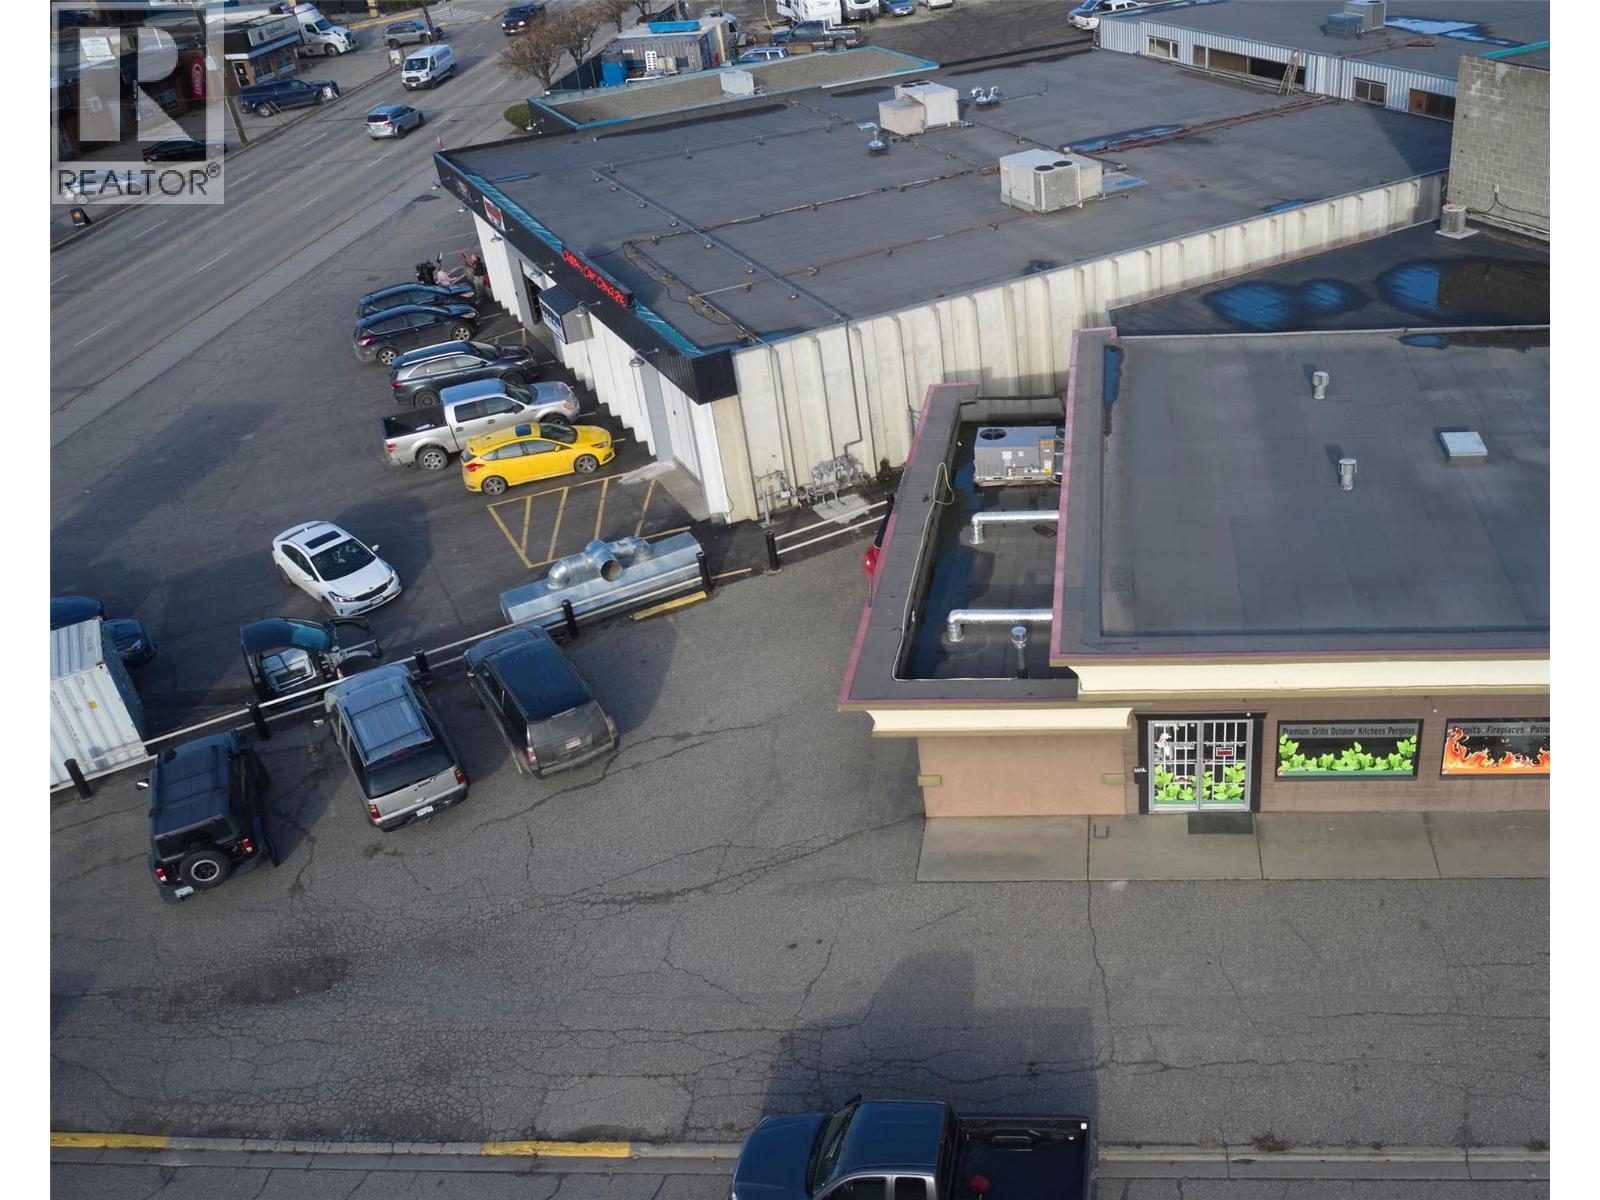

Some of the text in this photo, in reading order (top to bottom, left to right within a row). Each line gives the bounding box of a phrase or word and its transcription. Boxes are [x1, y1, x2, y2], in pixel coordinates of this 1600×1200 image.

[1282, 727, 1310, 736] Premium
[1311, 727, 1329, 736] Grills
[1331, 727, 1356, 736] Outdoor
[1358, 726, 1386, 735] Kitchens
[1487, 725, 1525, 735] Fireplaces
